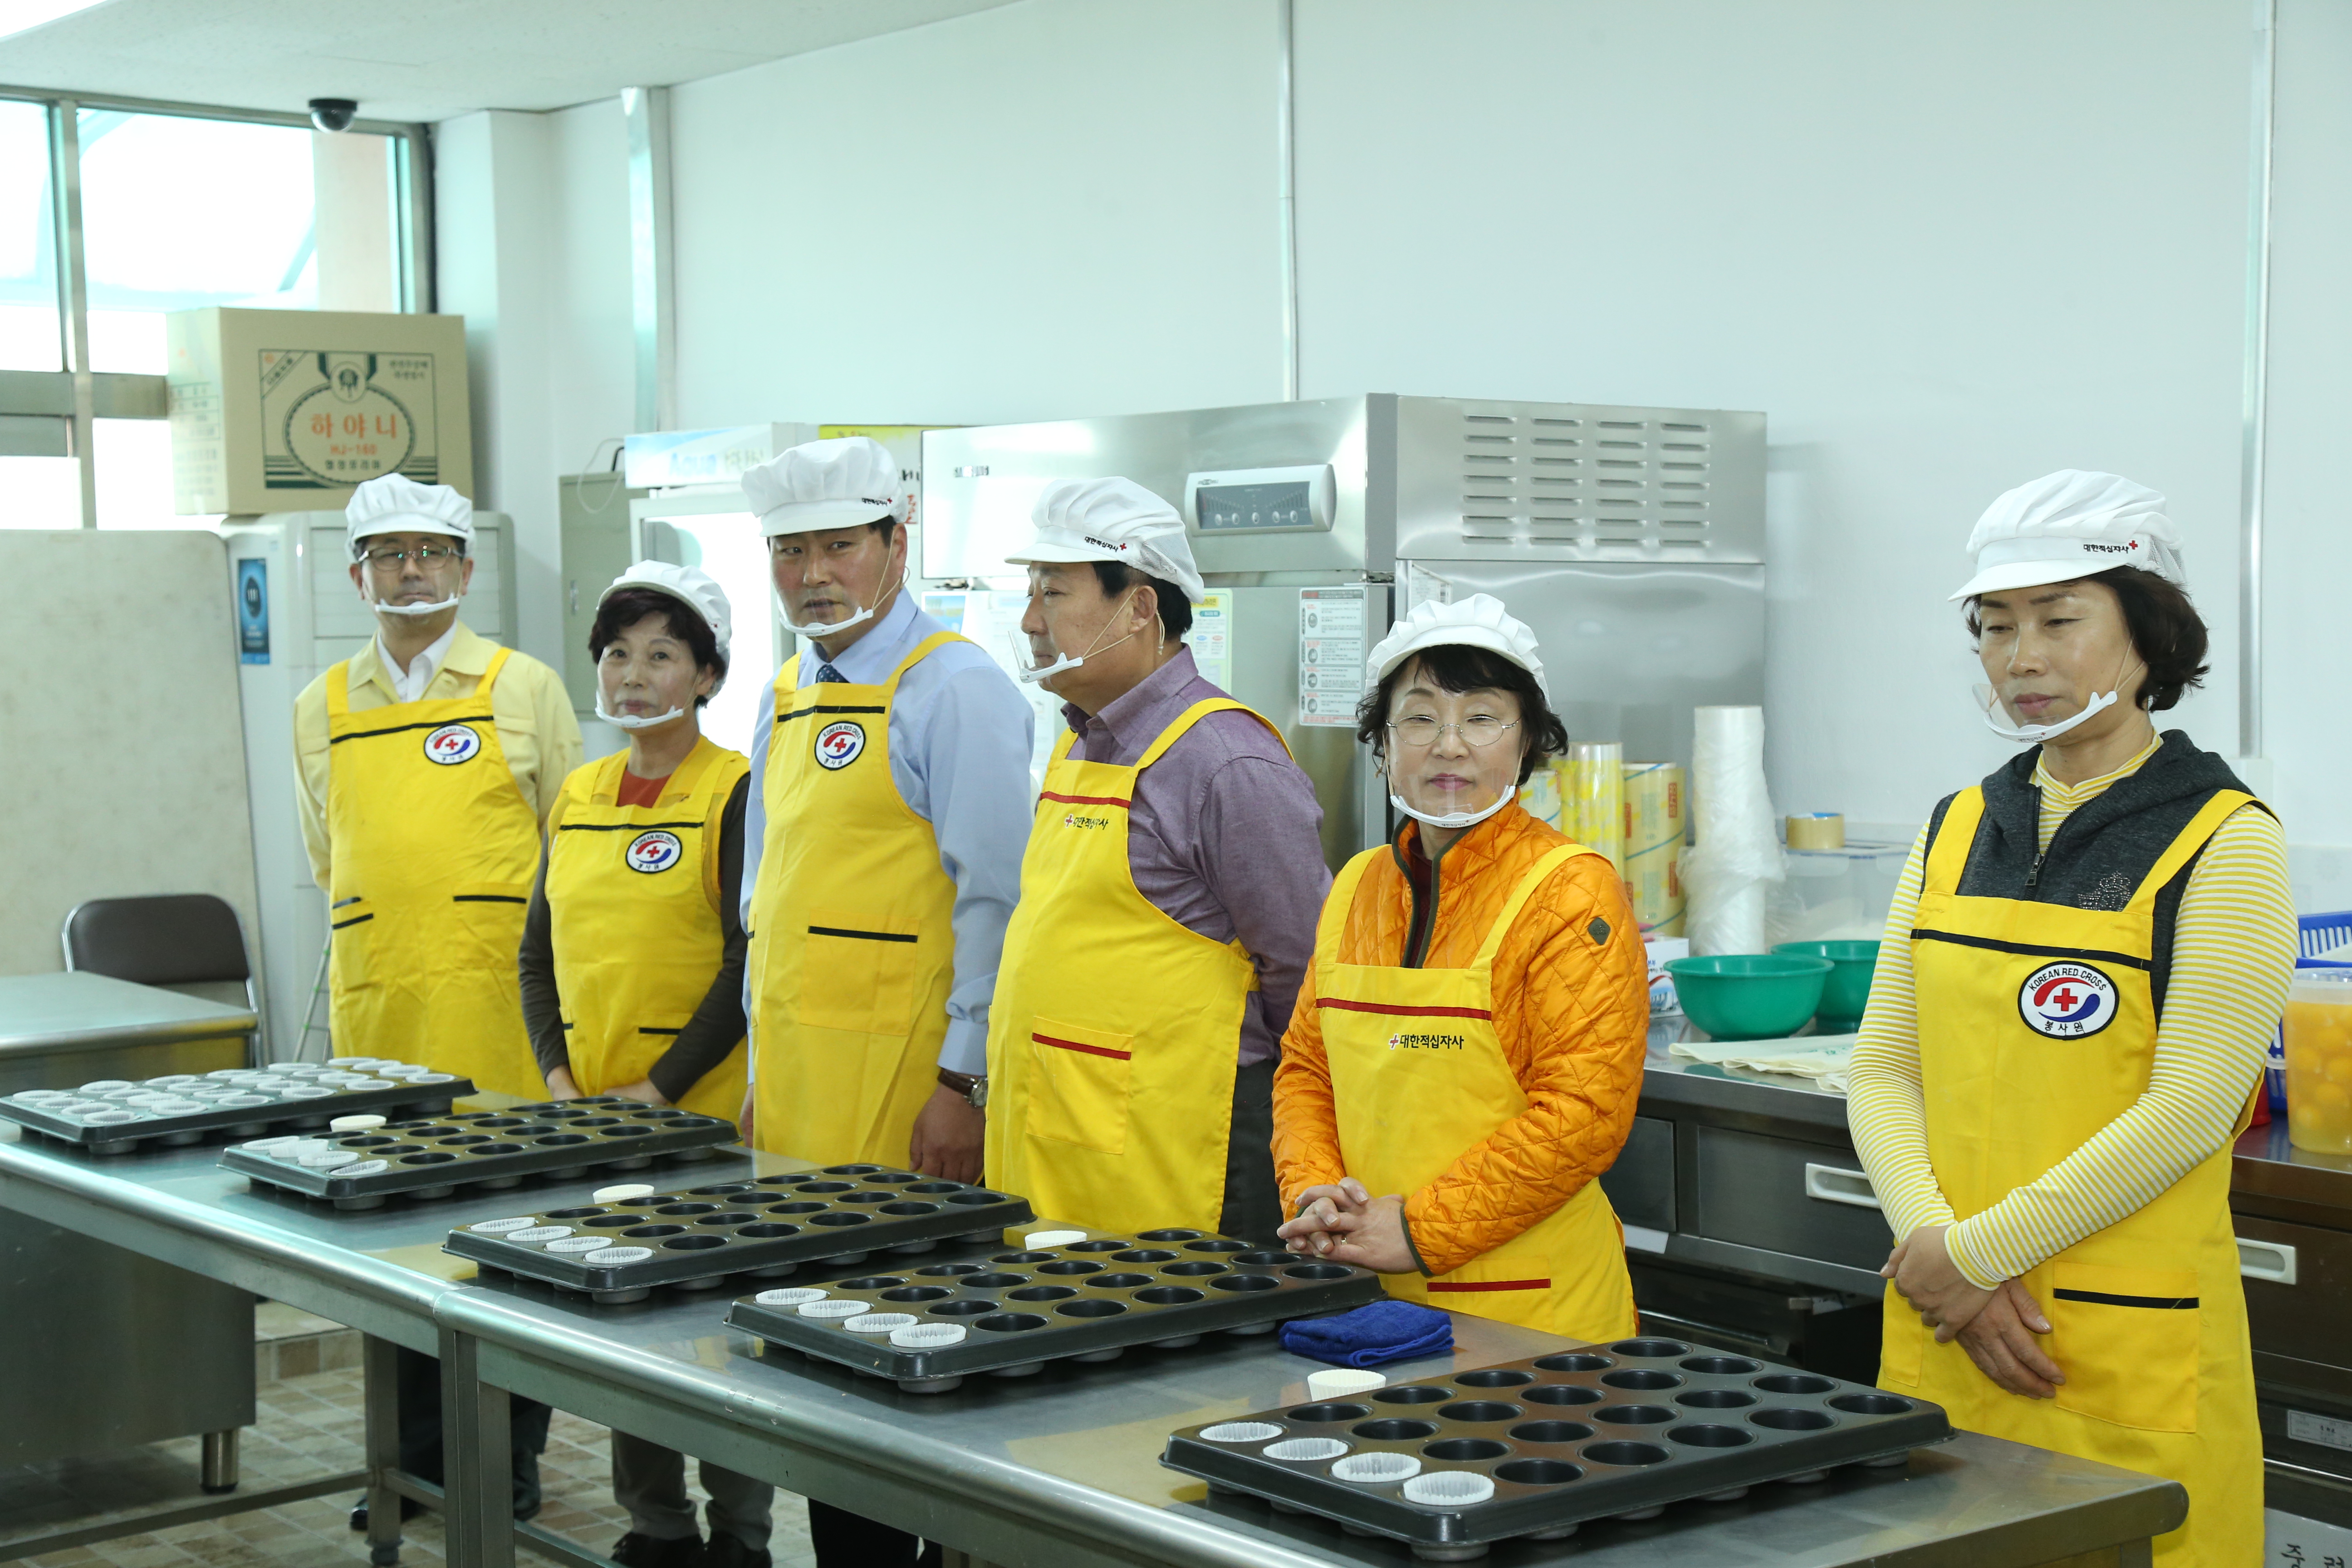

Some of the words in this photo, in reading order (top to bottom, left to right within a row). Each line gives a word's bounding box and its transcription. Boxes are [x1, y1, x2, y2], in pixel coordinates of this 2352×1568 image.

[1084, 536, 1118, 552] 대한적십자사
[2083, 544, 2129, 554] 대한적십자사
[823, 725, 843, 737] KOREAN
[635, 834, 654, 847] KOREAN
[2029, 969, 2060, 991] KOREAN
[2062, 968, 2078, 976] RED
[2081, 970, 2107, 991] CROSS
[2044, 1021, 2084, 1033] 봉사원
[1400, 1034, 1465, 1049] 대한적십자사
